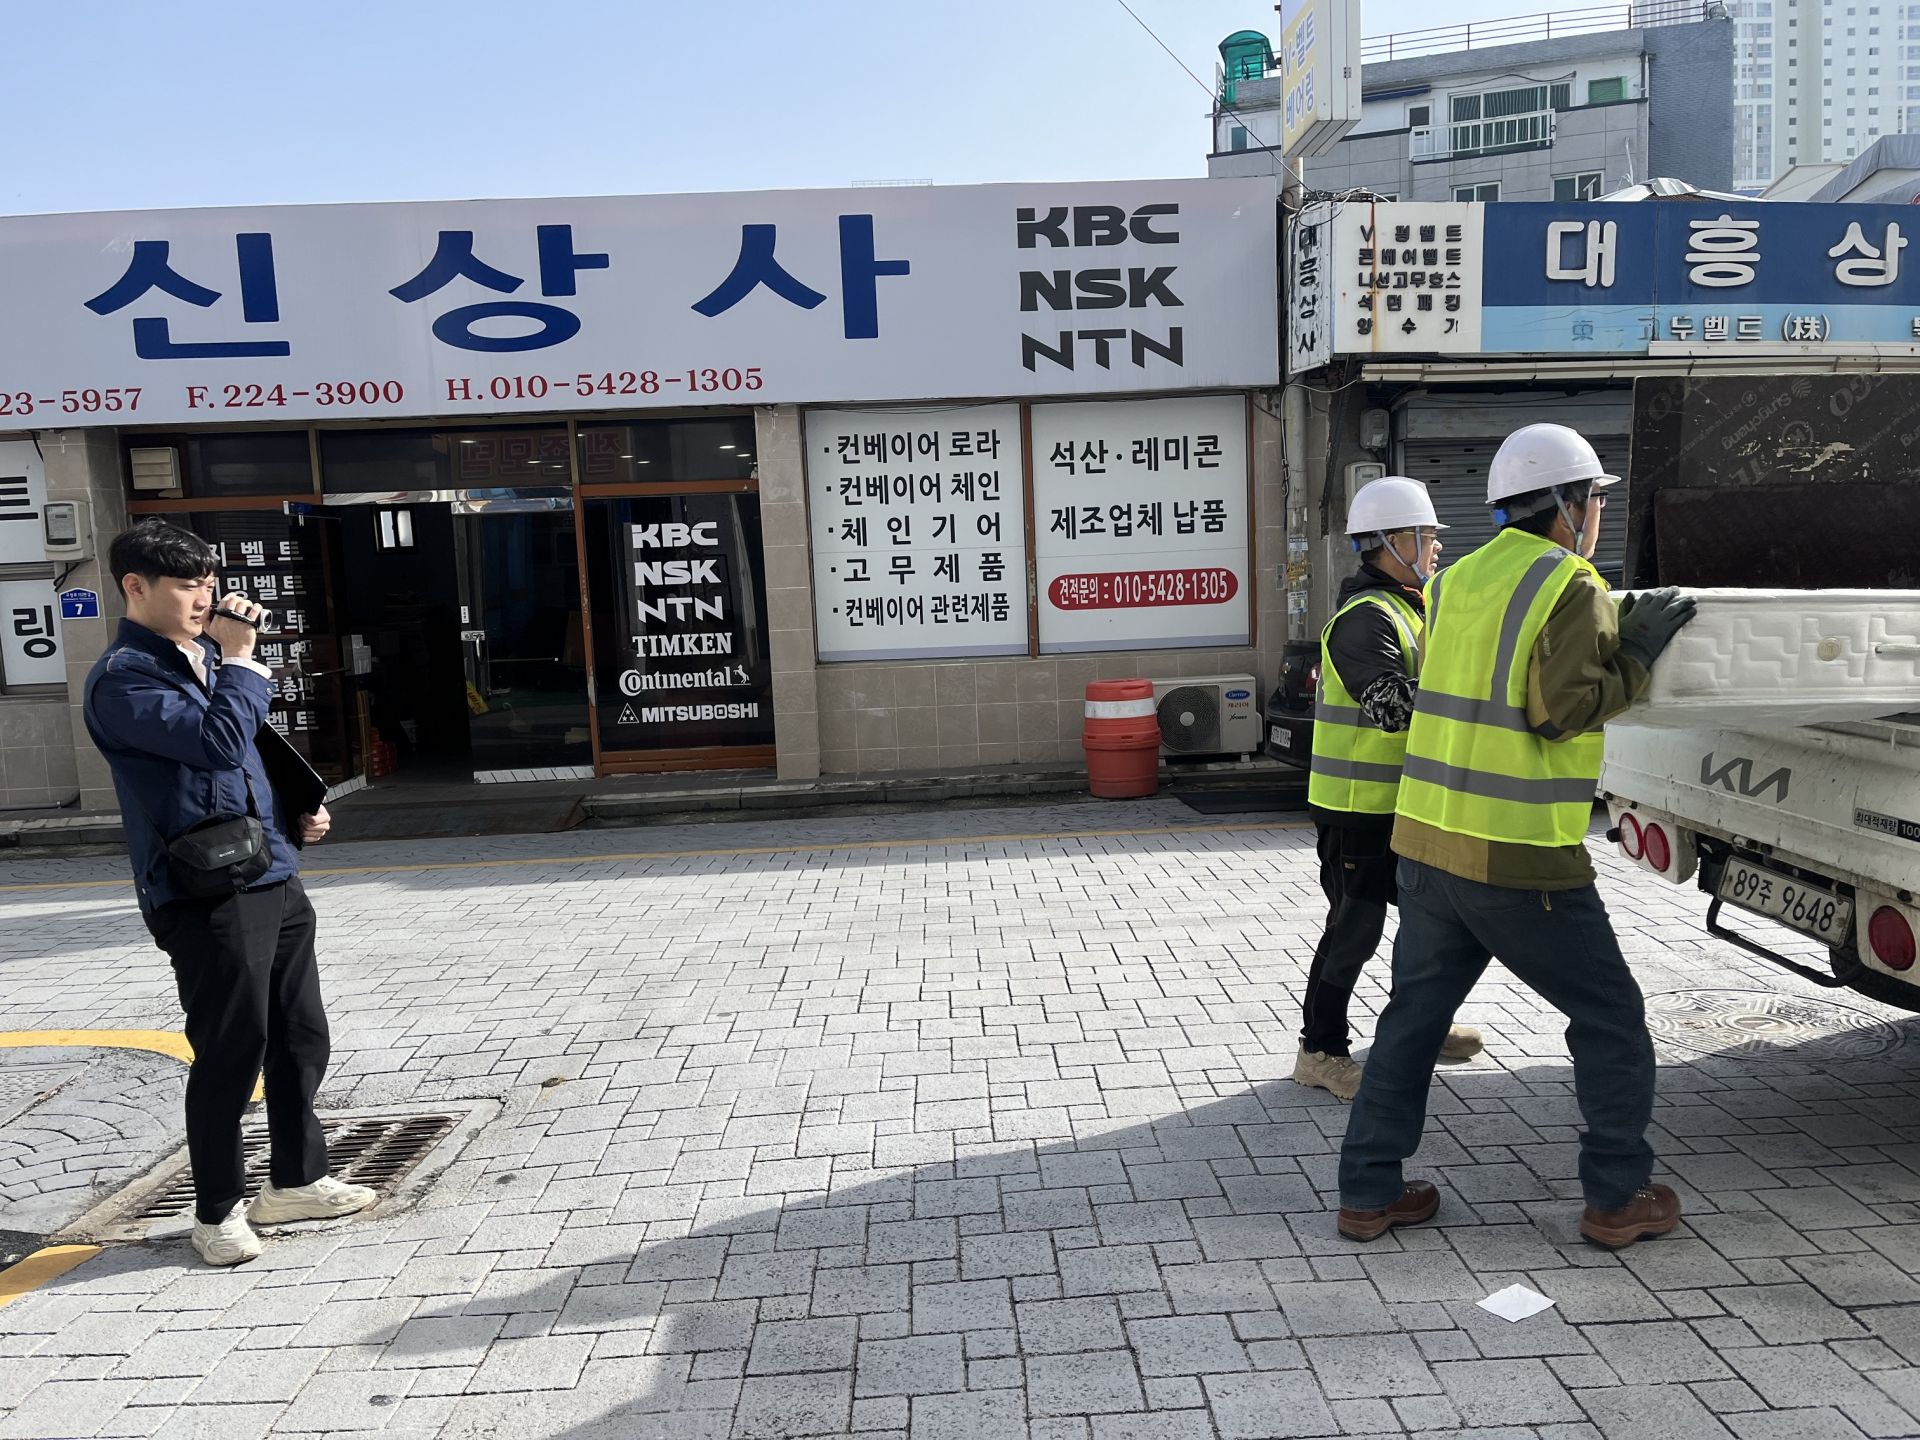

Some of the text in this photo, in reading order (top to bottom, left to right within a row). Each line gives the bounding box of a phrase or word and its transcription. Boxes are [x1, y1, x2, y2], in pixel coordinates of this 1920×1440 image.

[1286, 66, 1314, 131] 베어링
[1016, 203, 1180, 248] KBC
[1019, 266, 1185, 311] NSK
[1021, 326, 1184, 373] NTN
[837, 429, 1001, 464] 컨베이어 로라
[839, 470, 1001, 506] 컨베이어 체인
[631, 521, 719, 549] KBC
[1050, 499, 1228, 540] 제조업체 납품
[634, 559, 722, 586] NSK
[1114, 570, 1228, 603] 010-5428-1305
[74, 603, 83, 615] 7
[637, 595, 724, 624] NTN
[845, 592, 1010, 627] 컨베이어 관련제품
[12, 604, 57, 659] 링
[632, 632, 733, 658] TIMKEN
[619, 666, 732, 697] Continental
[641, 702, 759, 723] MITSUBOSHI
[1733, 868, 1836, 933] 89주 9648
